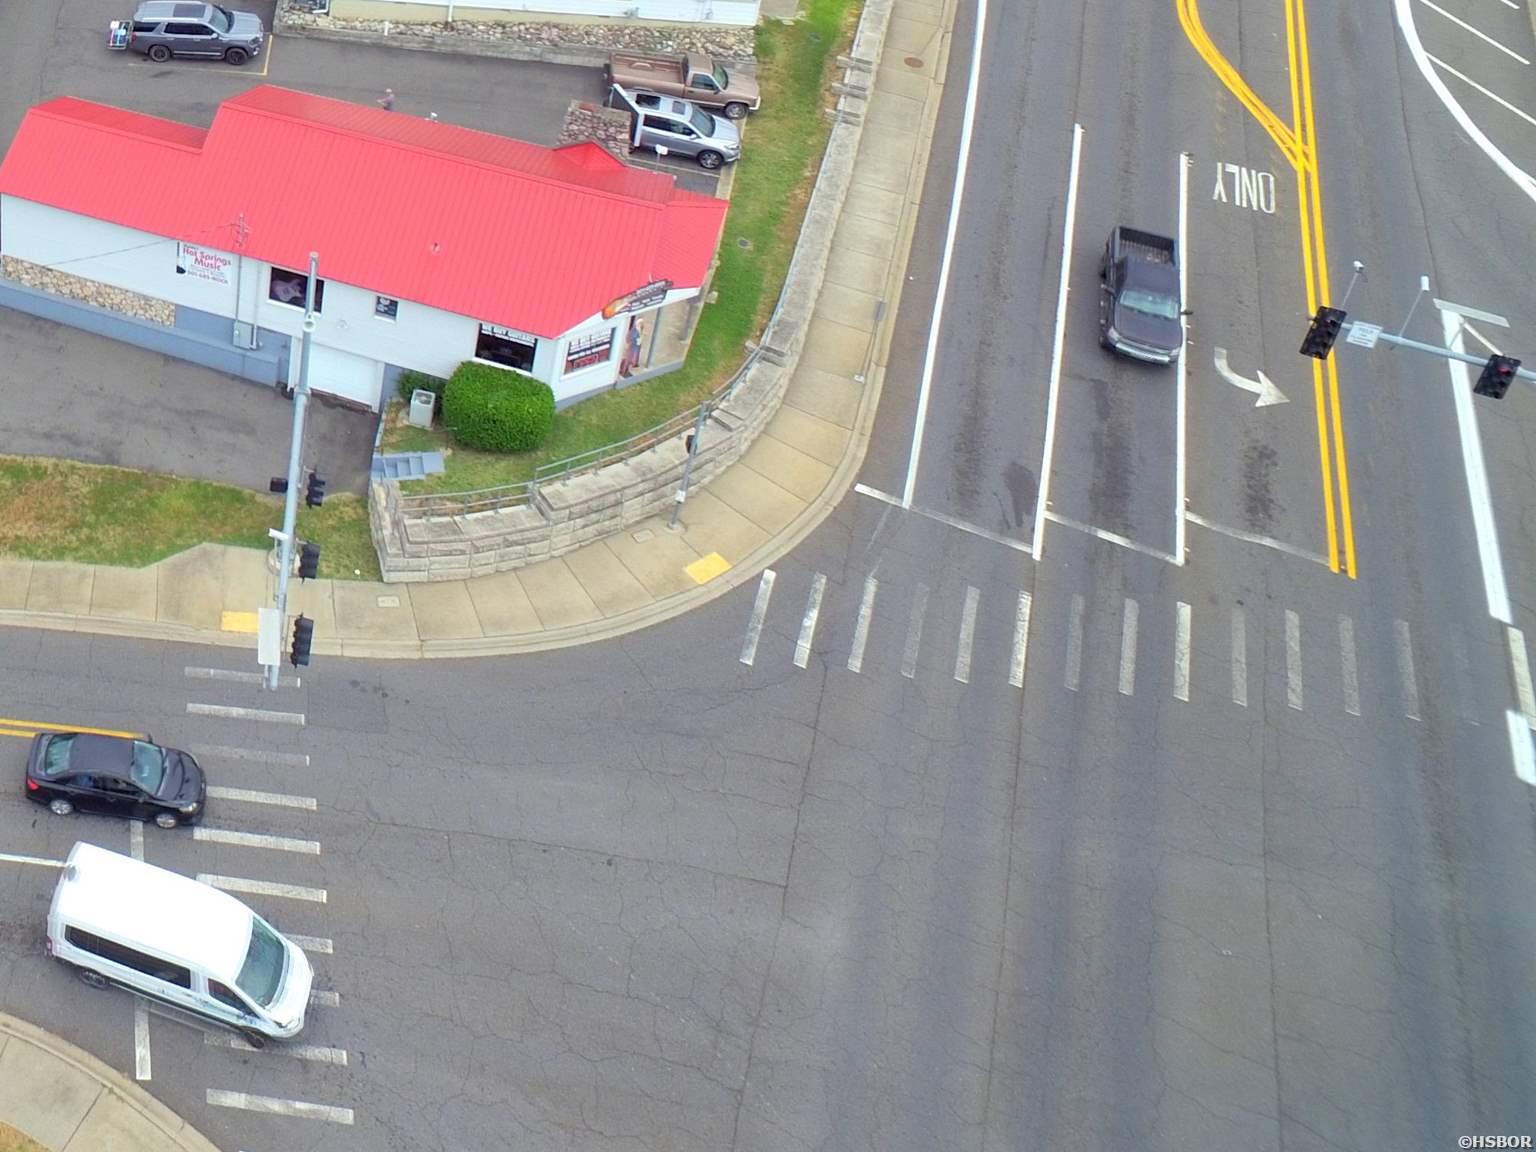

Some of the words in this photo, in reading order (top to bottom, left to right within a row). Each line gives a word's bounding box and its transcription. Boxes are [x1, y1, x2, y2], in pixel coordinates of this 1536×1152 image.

[1212, 161, 1276, 214] ONLY
[183, 247, 197, 257] Hot
[199, 251, 232, 266] Springs
[194, 257, 222, 272] Music
